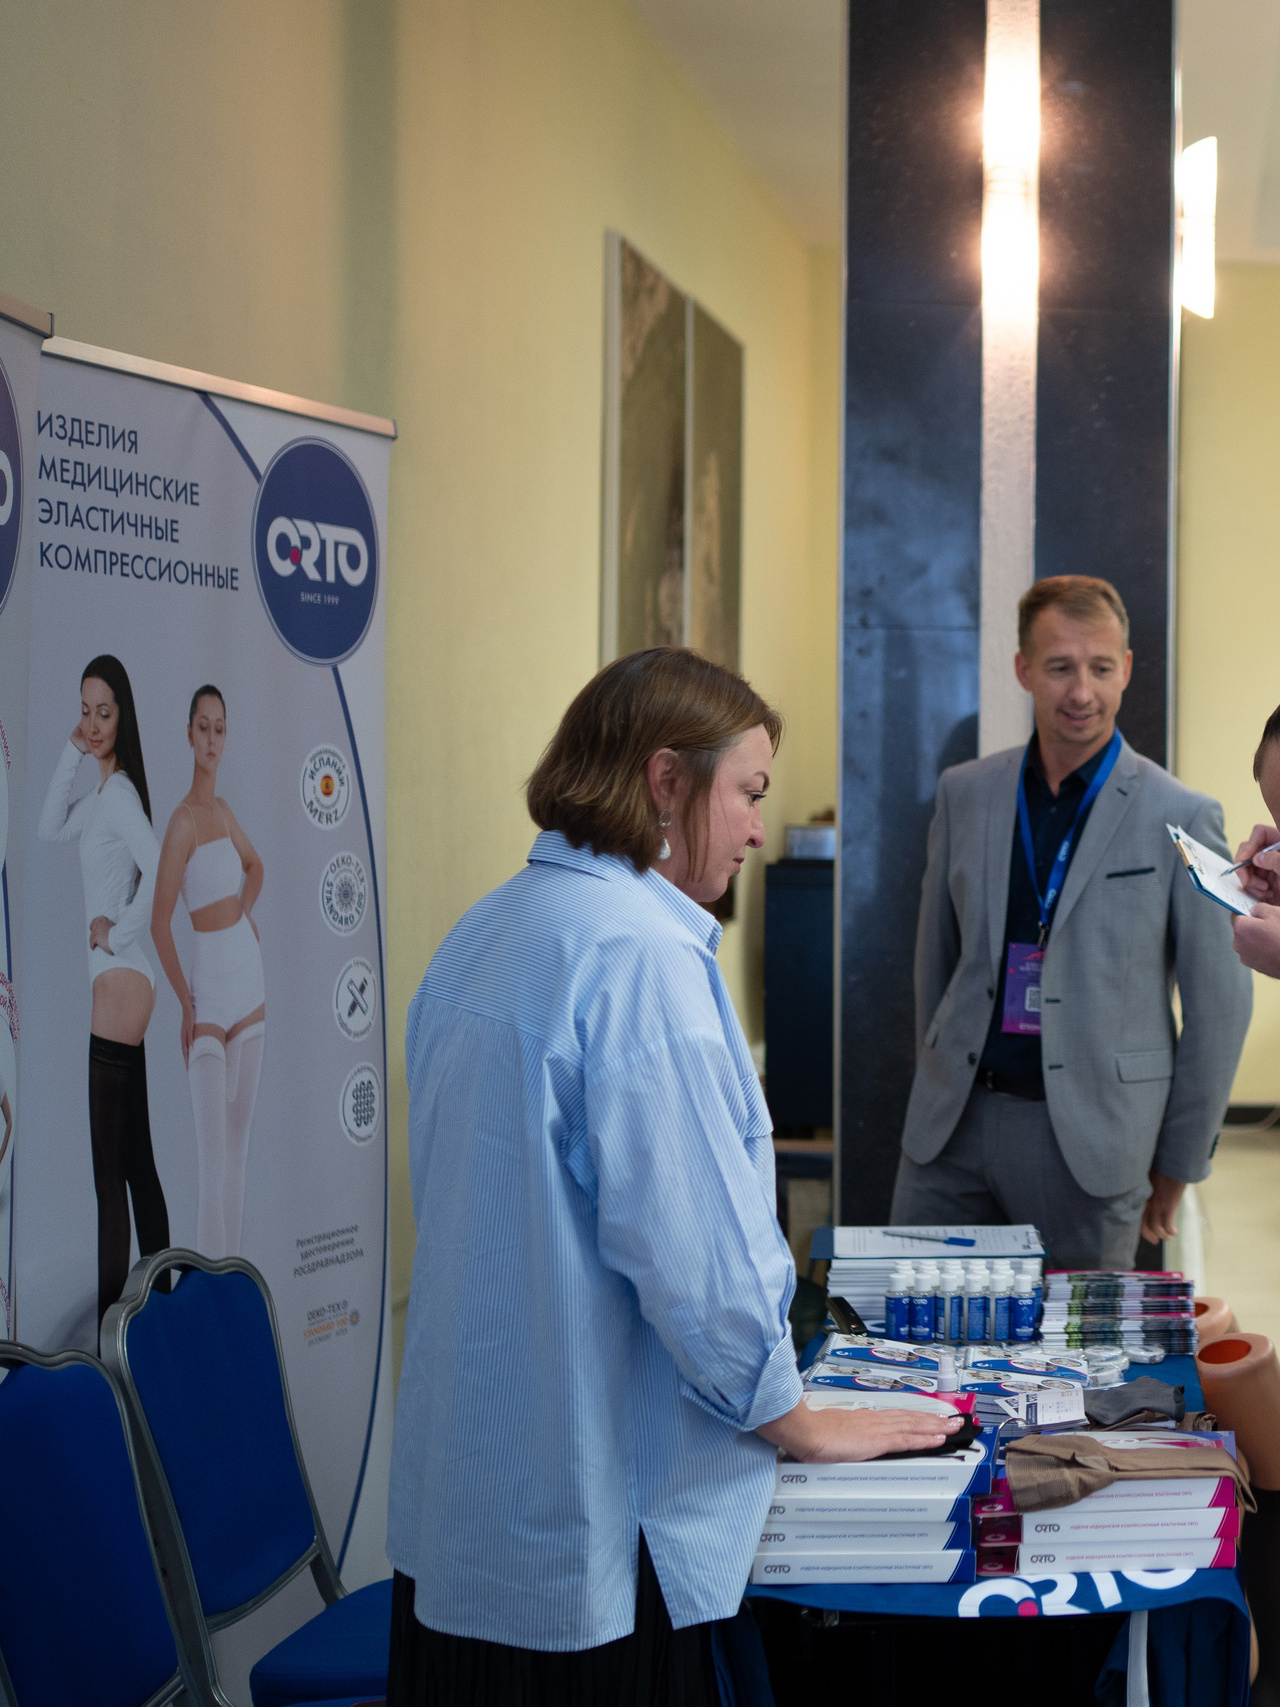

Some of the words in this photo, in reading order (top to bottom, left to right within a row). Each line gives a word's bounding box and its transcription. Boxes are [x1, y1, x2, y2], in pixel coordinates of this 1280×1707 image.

[37, 410, 138, 455] ИЗДЕЛИЯ
[38, 454, 200, 507] МЕДИЦИНСКИЕ
[38, 498, 180, 544] ЭЛАСТИЧНЫЕ
[266, 516, 368, 587] ORTO
[39, 541, 240, 591] КОМПРЕССИОННЫЕ
[300, 591, 321, 605] SINCE
[323, 593, 340, 606] 1999
[307, 800, 339, 825] MERZ
[781, 1475, 807, 1483] ORTO
[768, 1506, 785, 1515] RTO
[1035, 1524, 1060, 1533] ORTO
[760, 1534, 785, 1542] ORTO
[1030, 1555, 1055, 1564] ORTO
[764, 1565, 790, 1573] ORTO
